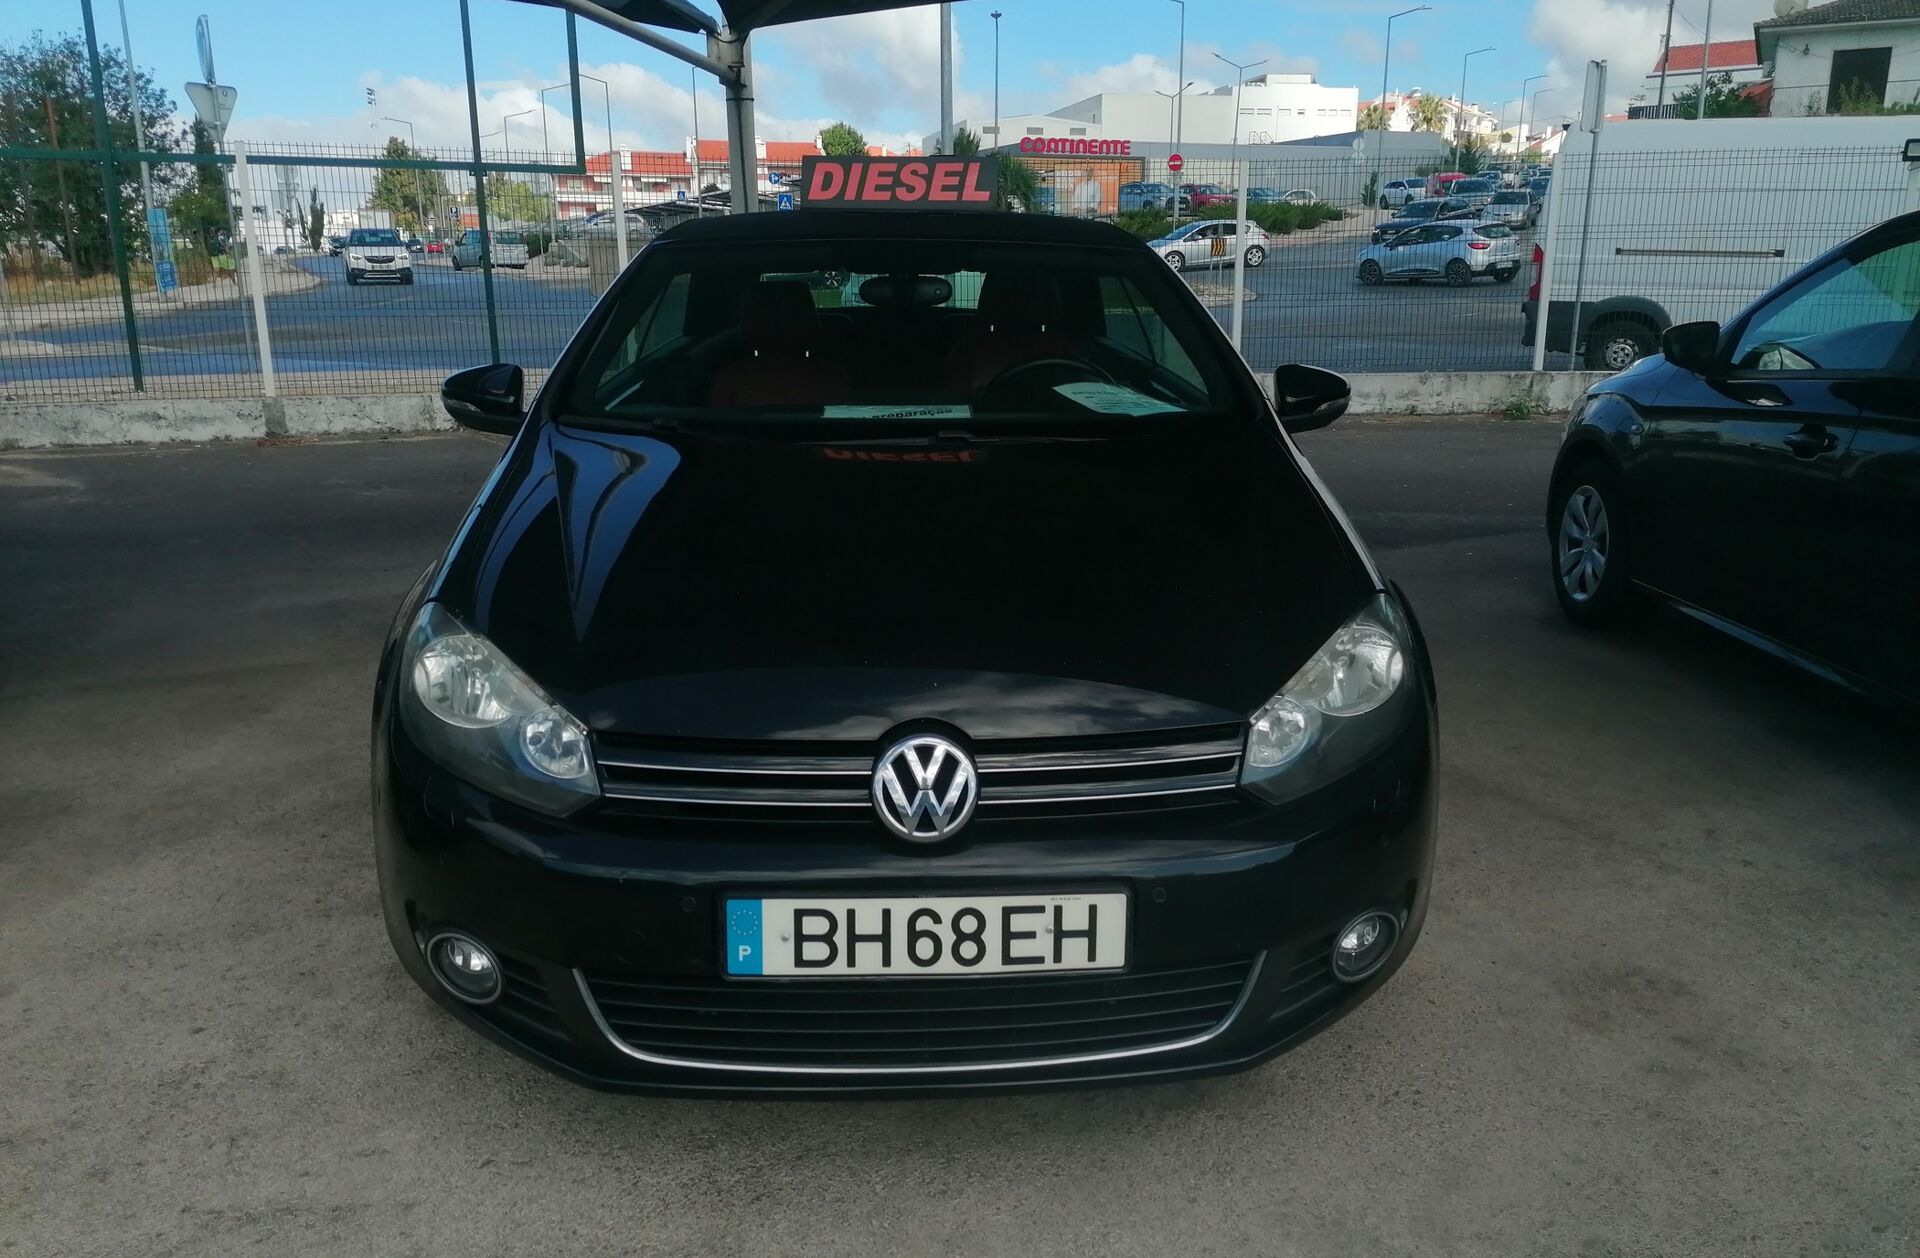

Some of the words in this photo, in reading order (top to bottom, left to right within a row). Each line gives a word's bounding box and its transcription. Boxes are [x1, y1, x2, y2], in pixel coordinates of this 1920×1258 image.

[1019, 136, 1131, 155] CONTINENTE
[807, 162, 991, 201] DIESEL
[738, 945, 751, 962] P
